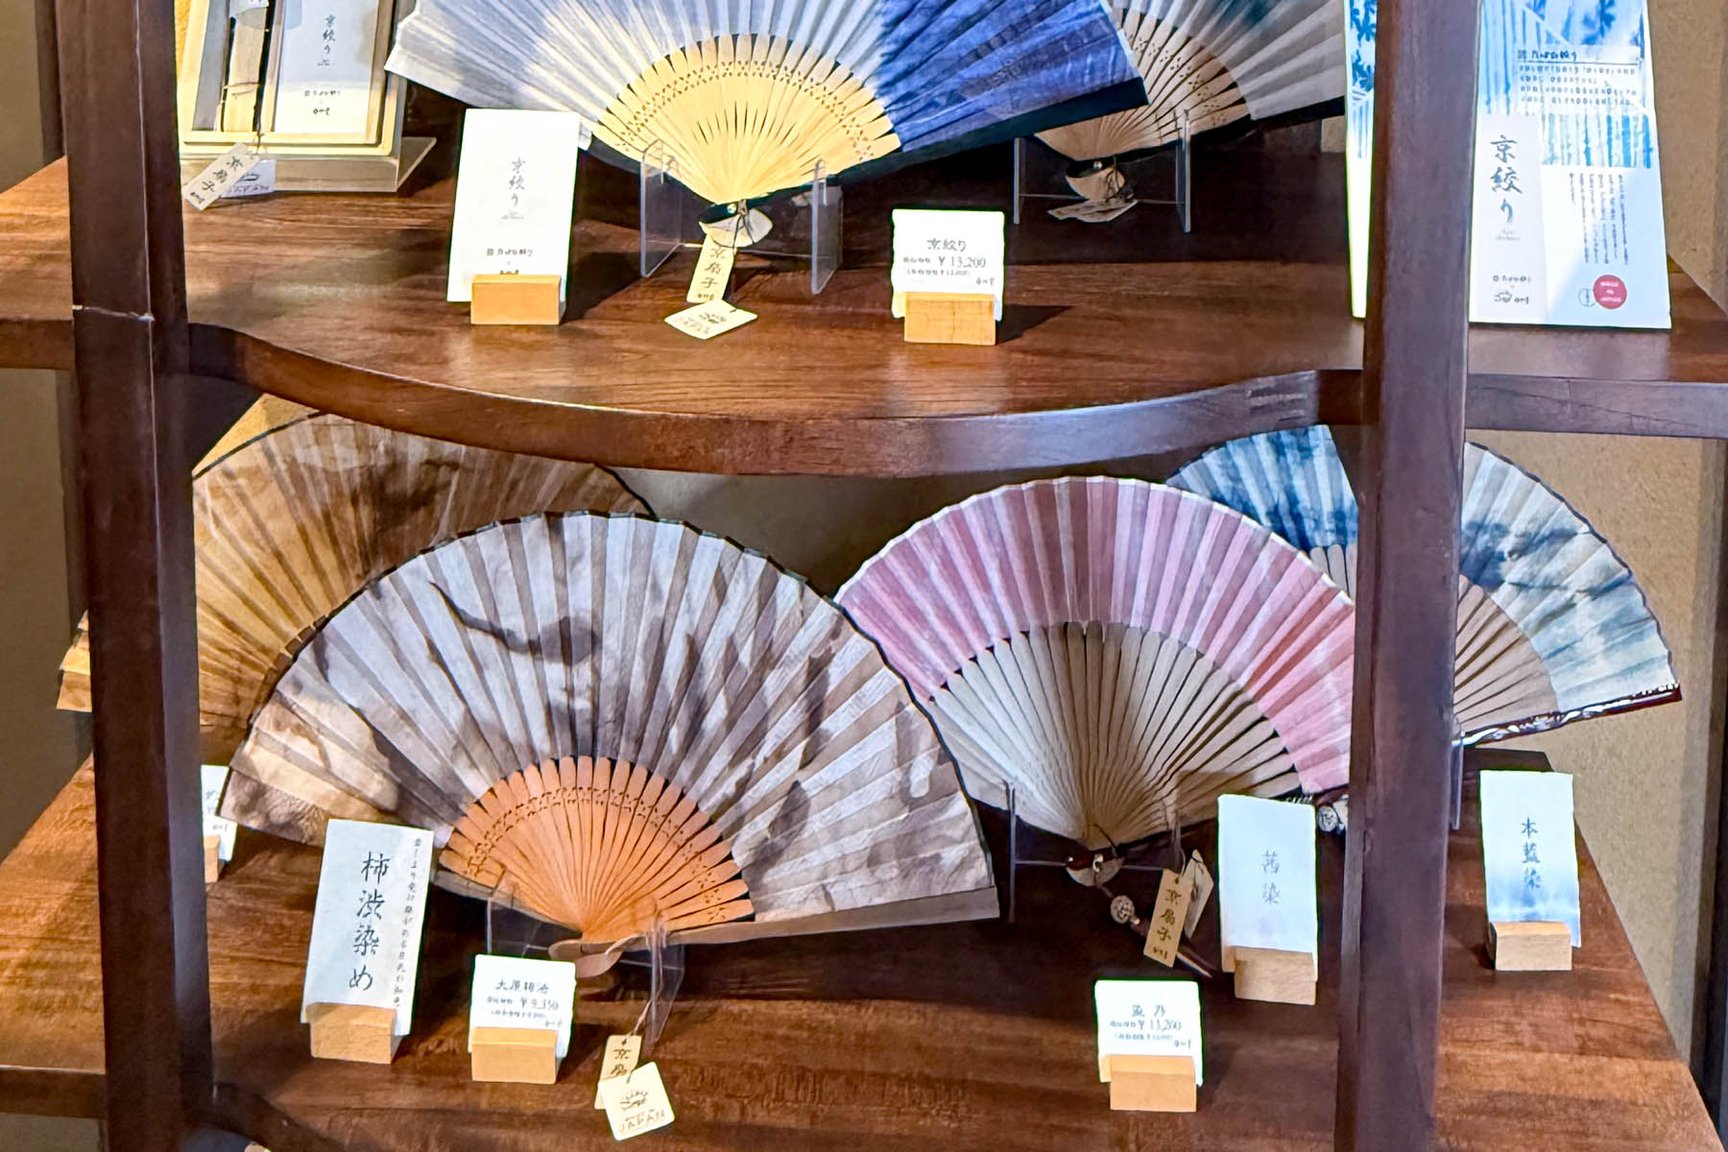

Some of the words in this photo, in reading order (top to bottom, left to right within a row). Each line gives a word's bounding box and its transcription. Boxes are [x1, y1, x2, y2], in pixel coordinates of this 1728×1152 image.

[1490, 134, 1524, 223] 京絞り
[1521, 817, 1541, 889] 本藍染
[349, 850, 391, 992] 柿渋染め
